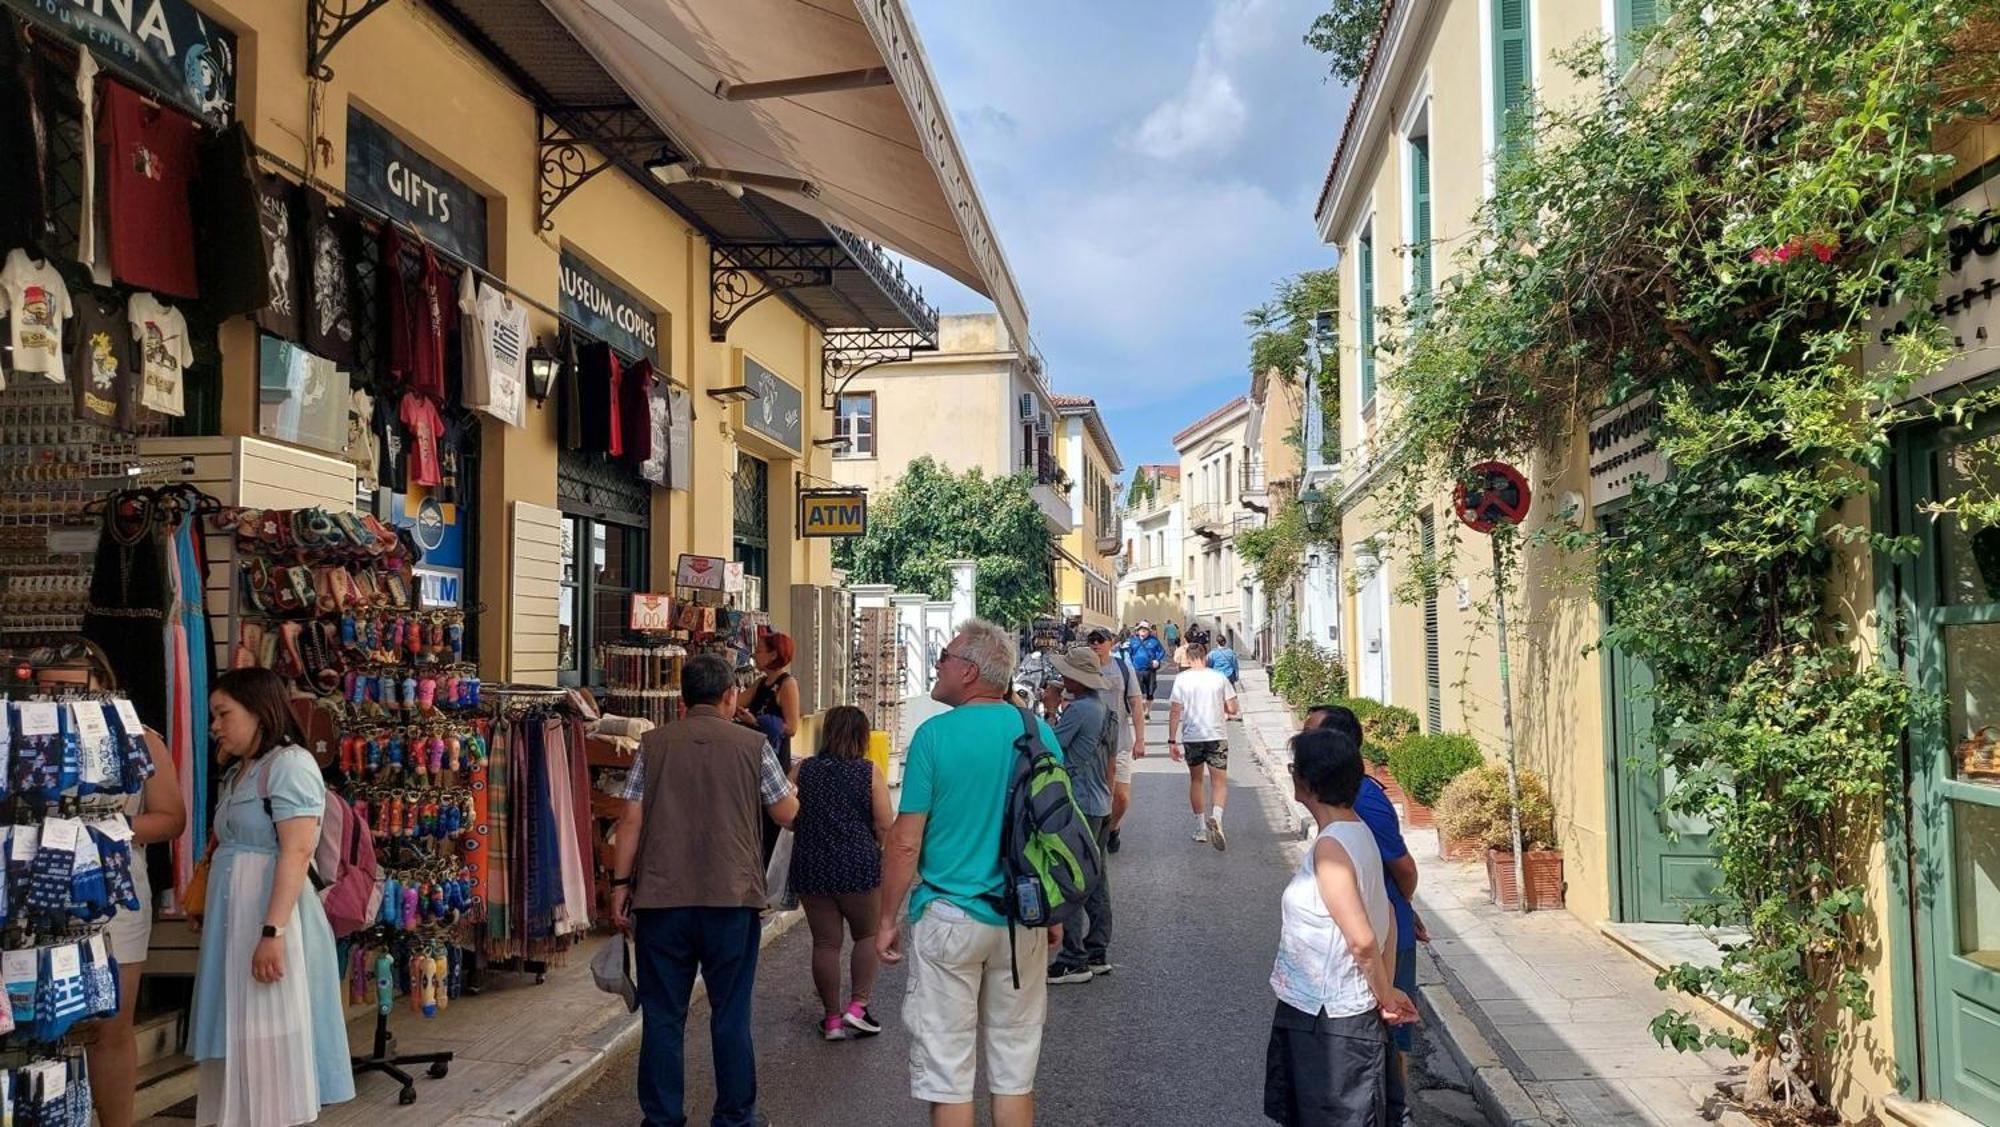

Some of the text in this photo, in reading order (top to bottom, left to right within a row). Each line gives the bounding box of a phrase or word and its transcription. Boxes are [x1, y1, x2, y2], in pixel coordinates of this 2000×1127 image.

[387, 161, 450, 223] GIFTS
[616, 304, 656, 348] COPIES
[808, 504, 861, 526] ATM
